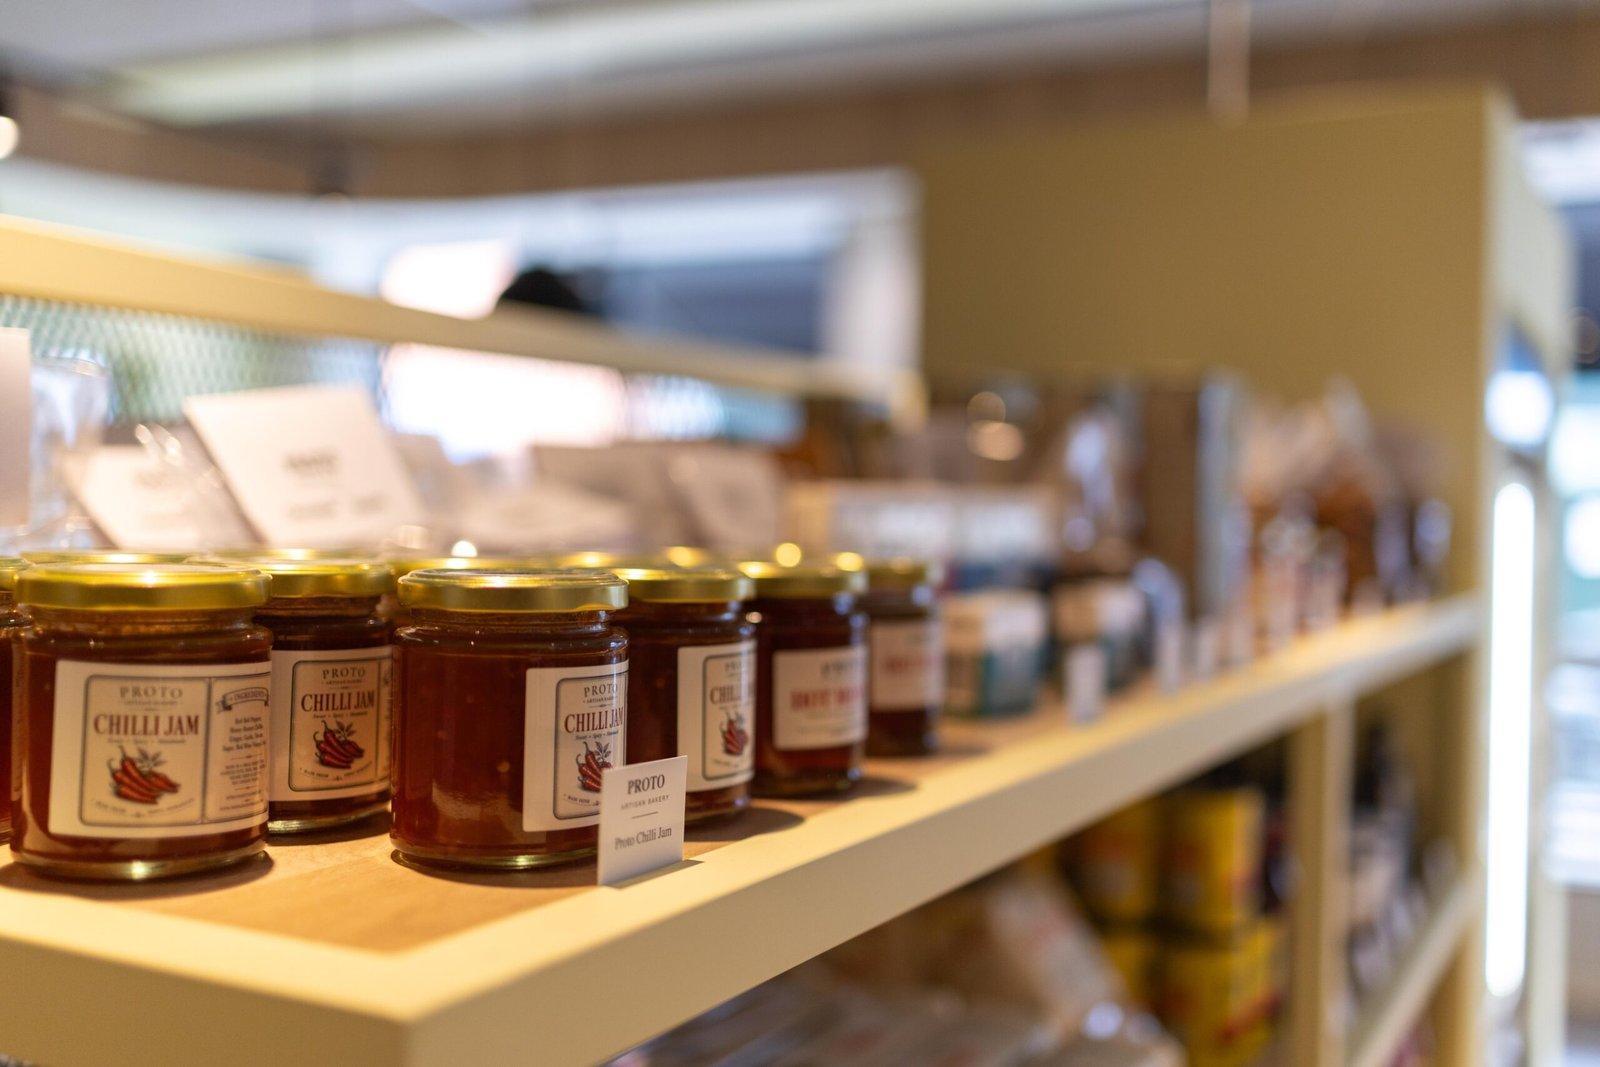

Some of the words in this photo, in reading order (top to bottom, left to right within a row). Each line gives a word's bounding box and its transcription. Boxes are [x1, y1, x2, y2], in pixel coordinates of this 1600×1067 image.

[322, 667, 366, 680] PROTO
[120, 686, 183, 699] PROTO
[584, 683, 618, 698] PROTO
[301, 692, 352, 713] CHILLI
[354, 690, 375, 709] JAM
[93, 713, 160, 736] CHILLI
[163, 714, 200, 736] JAM
[564, 709, 609, 734] CHILLI
[627, 774, 666, 795] PROTO
[621, 799, 646, 810] ARTISAN
[647, 794, 670, 805] BAKERY
[614, 836, 636, 851] Proto
[636, 828, 657, 845] Chilli
[657, 826, 672, 840] Jam
